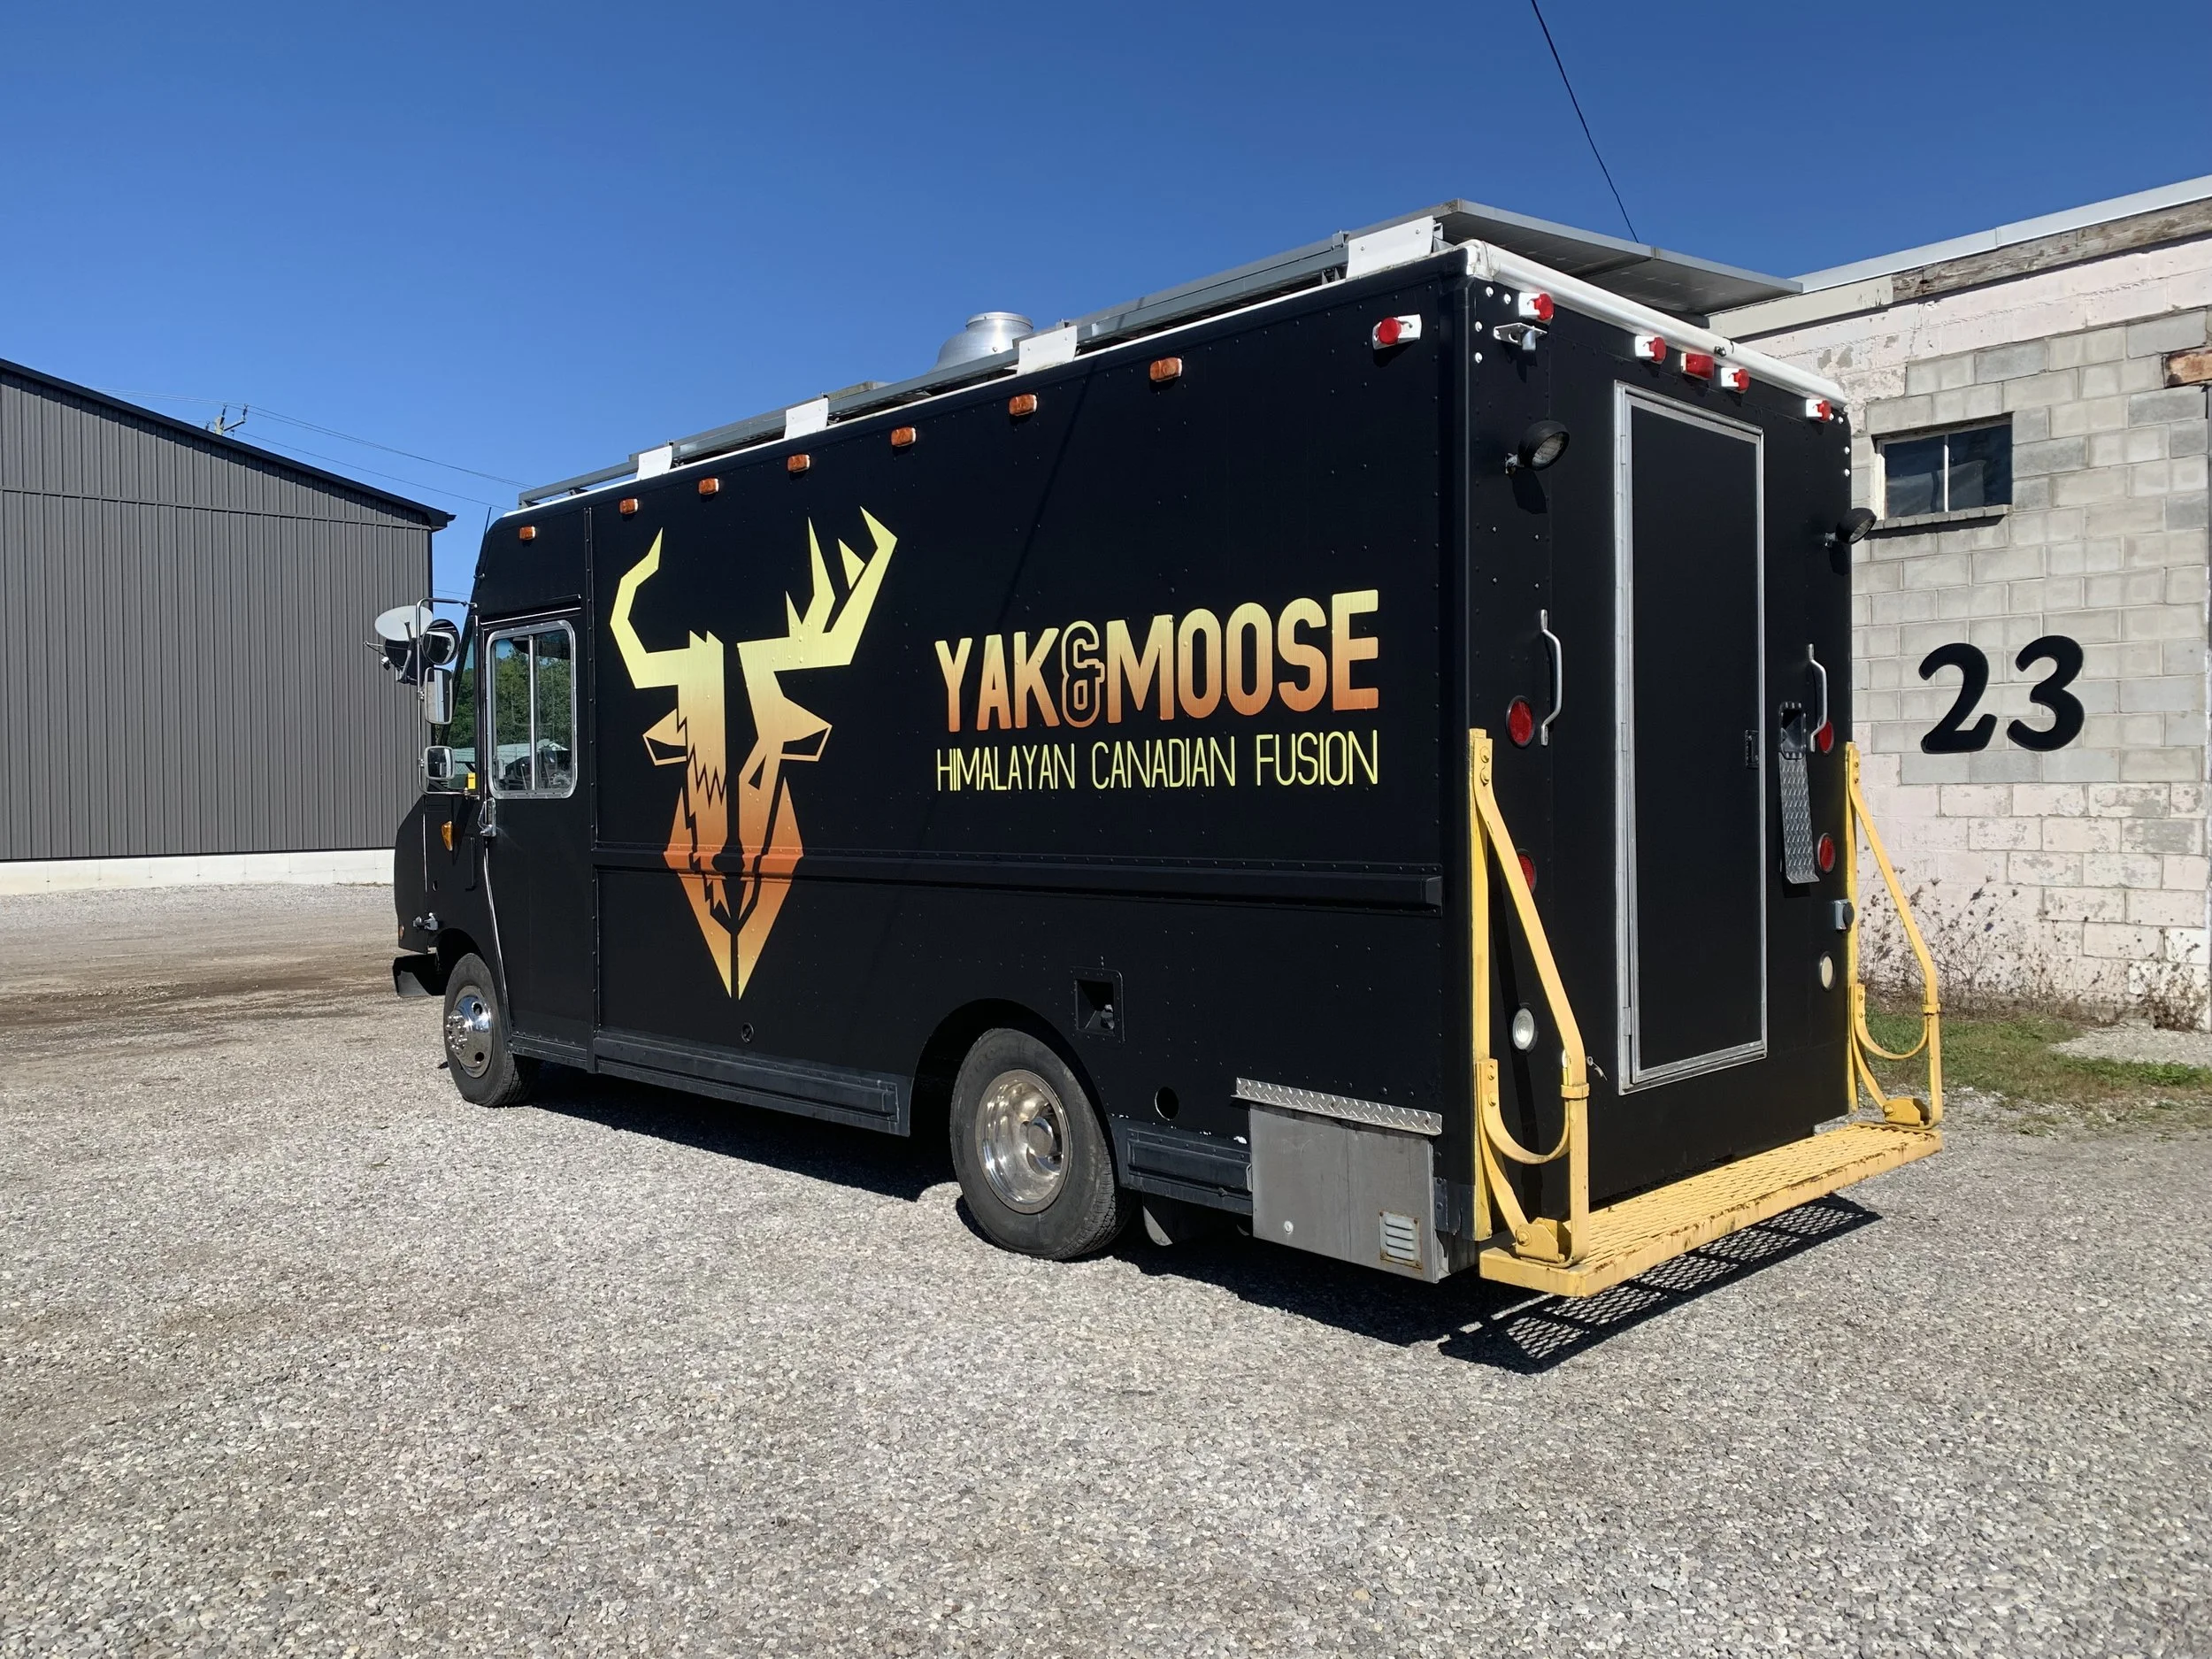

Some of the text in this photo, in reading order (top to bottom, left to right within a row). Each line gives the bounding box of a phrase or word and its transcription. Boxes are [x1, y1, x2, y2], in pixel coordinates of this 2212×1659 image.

[1918, 634, 2085, 755] 23
[937, 730, 1379, 791] HIMALAYAN CANADIAN FUSION
